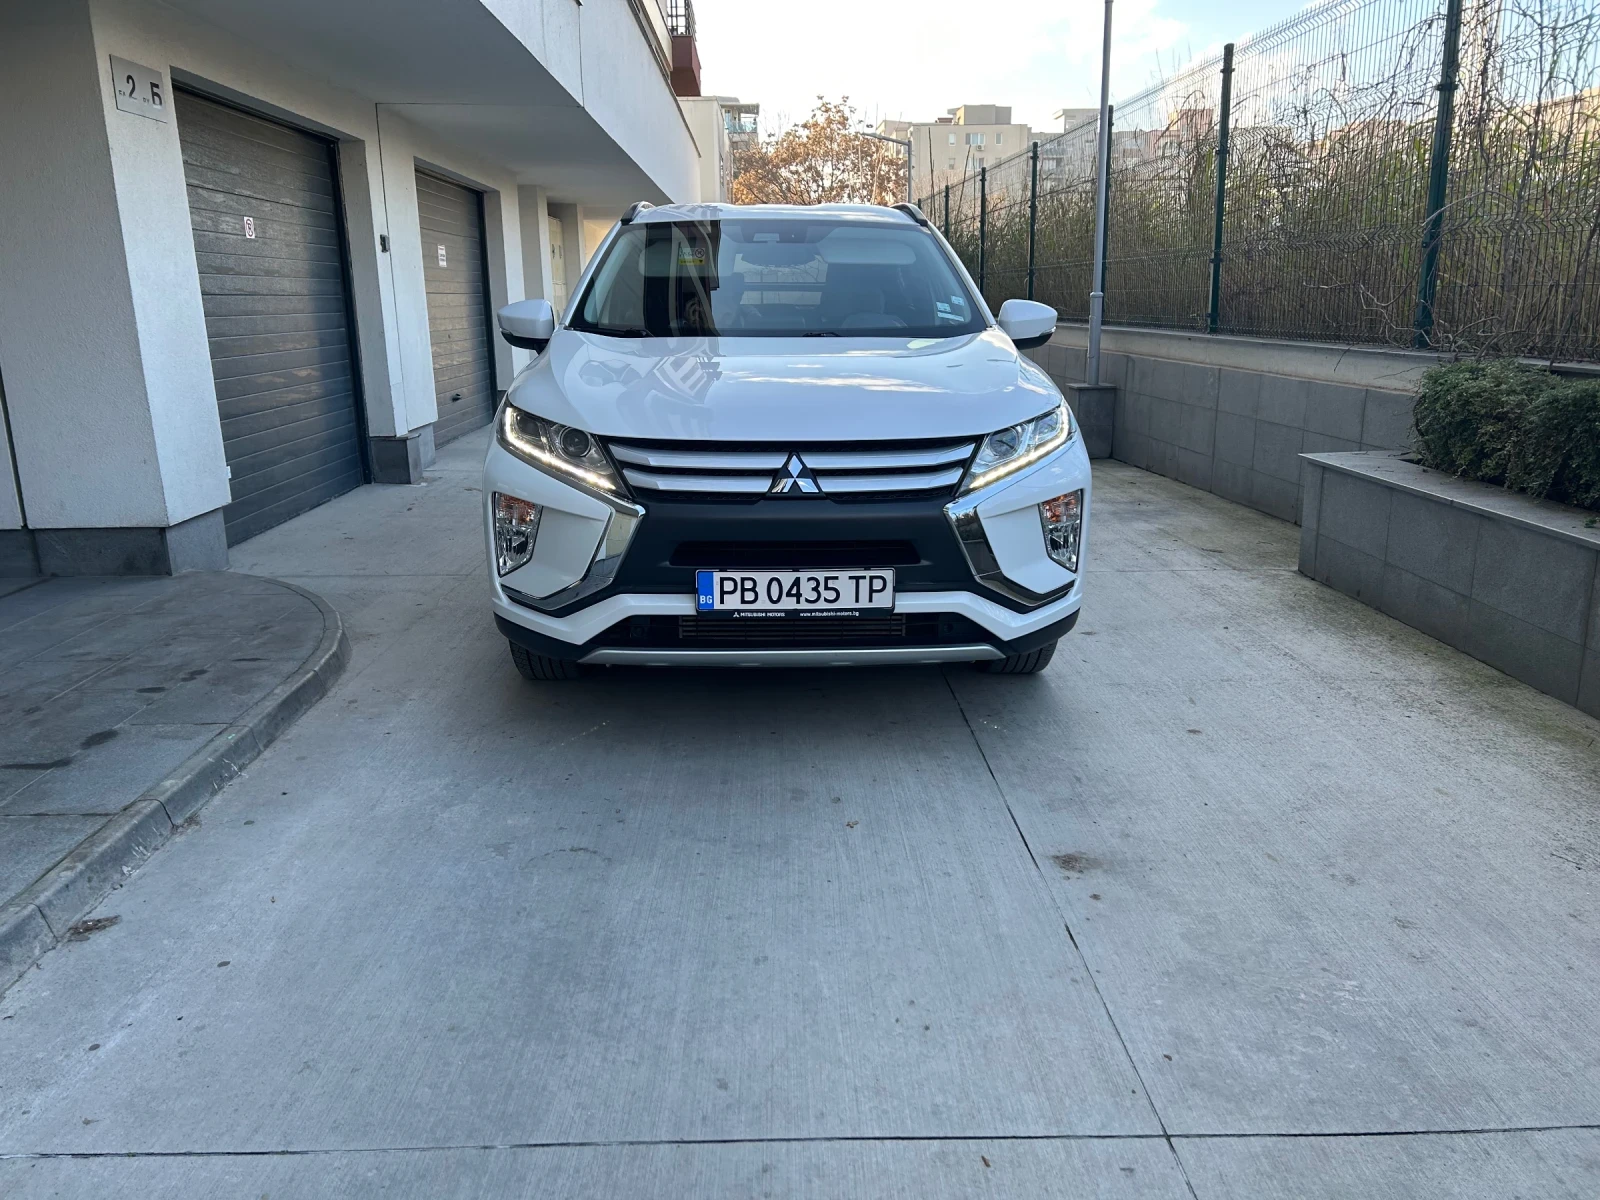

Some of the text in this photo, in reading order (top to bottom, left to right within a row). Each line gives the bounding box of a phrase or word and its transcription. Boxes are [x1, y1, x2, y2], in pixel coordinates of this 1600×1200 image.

[126, 74, 138, 100] 2
[699, 595, 713, 604] BG
[719, 575, 888, 605] PB 0435 TP
